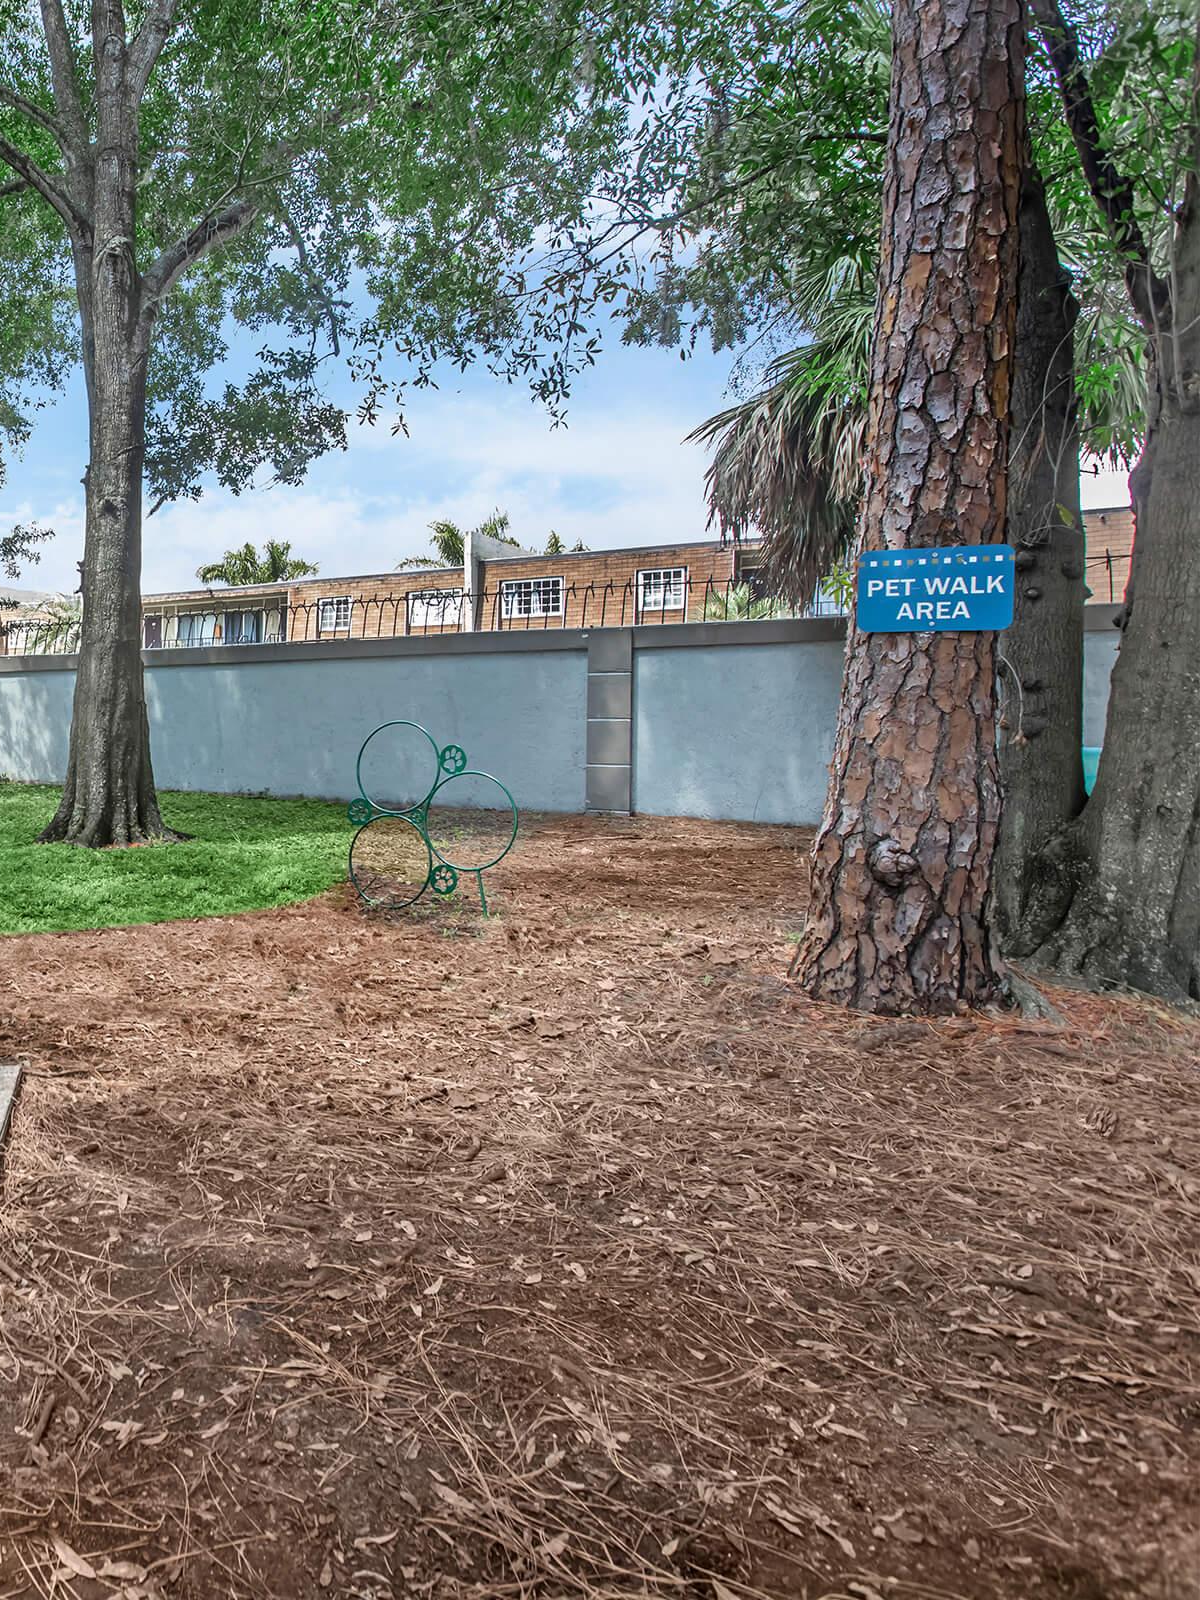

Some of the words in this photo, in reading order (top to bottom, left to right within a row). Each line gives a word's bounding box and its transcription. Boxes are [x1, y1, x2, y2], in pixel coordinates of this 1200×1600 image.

[867, 578, 916, 597] PET
[924, 575, 1005, 595] WALK
[896, 601, 971, 620] AREA
